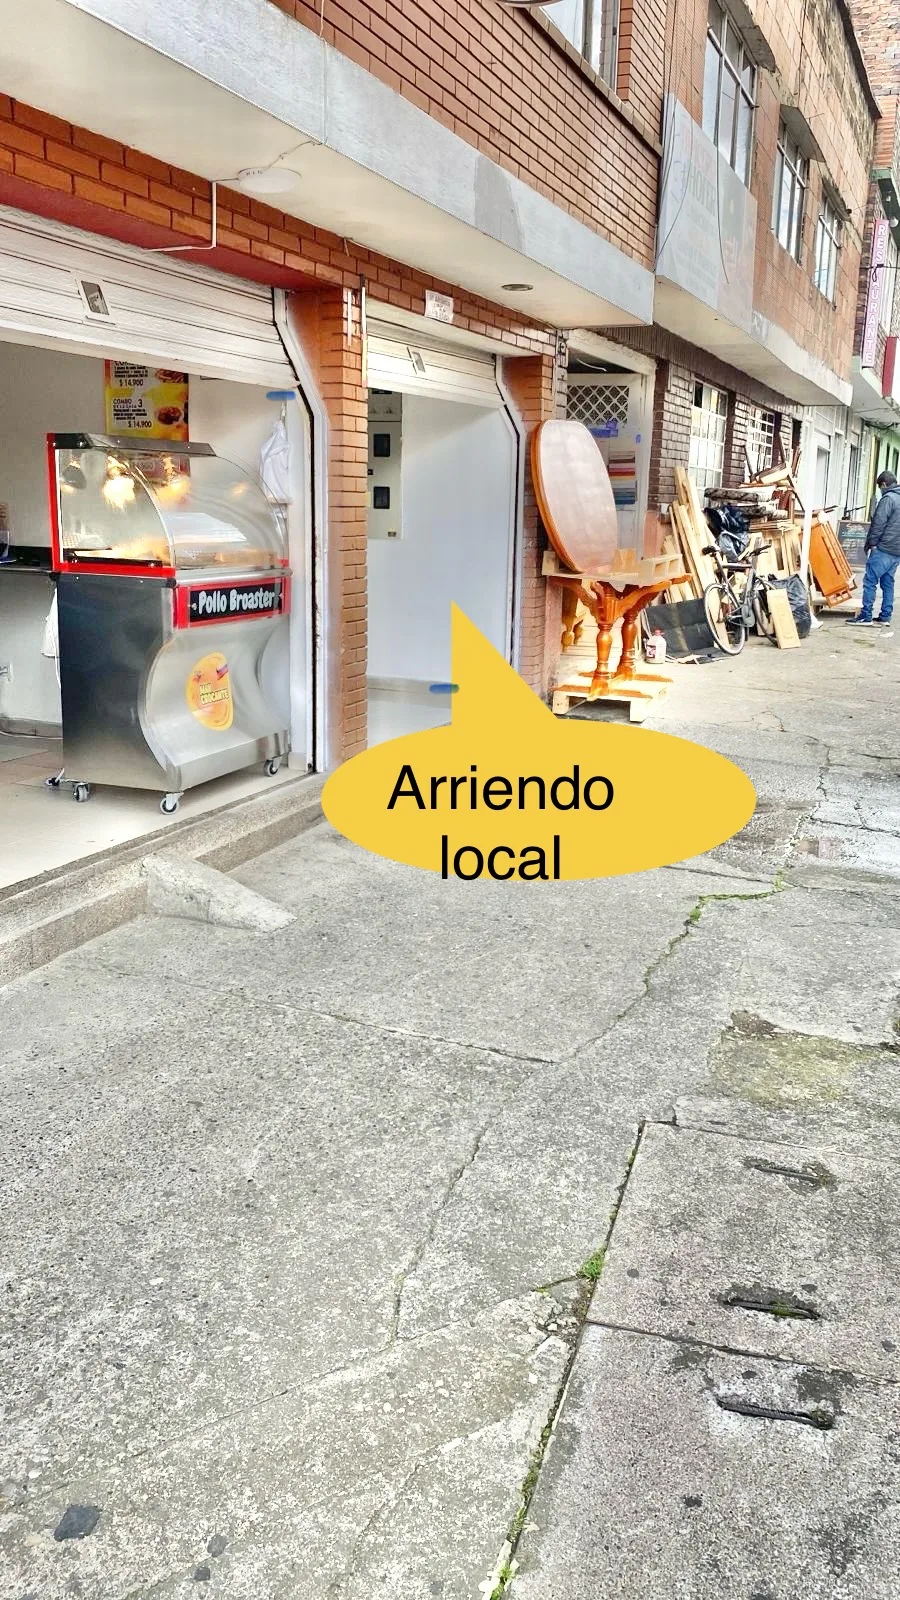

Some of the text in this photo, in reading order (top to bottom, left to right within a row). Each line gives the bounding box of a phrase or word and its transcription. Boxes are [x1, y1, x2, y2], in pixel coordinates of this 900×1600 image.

[137, 398, 143, 408] 3
[133, 420, 152, 428] 14.900
[198, 587, 275, 615] Pollo Broaster
